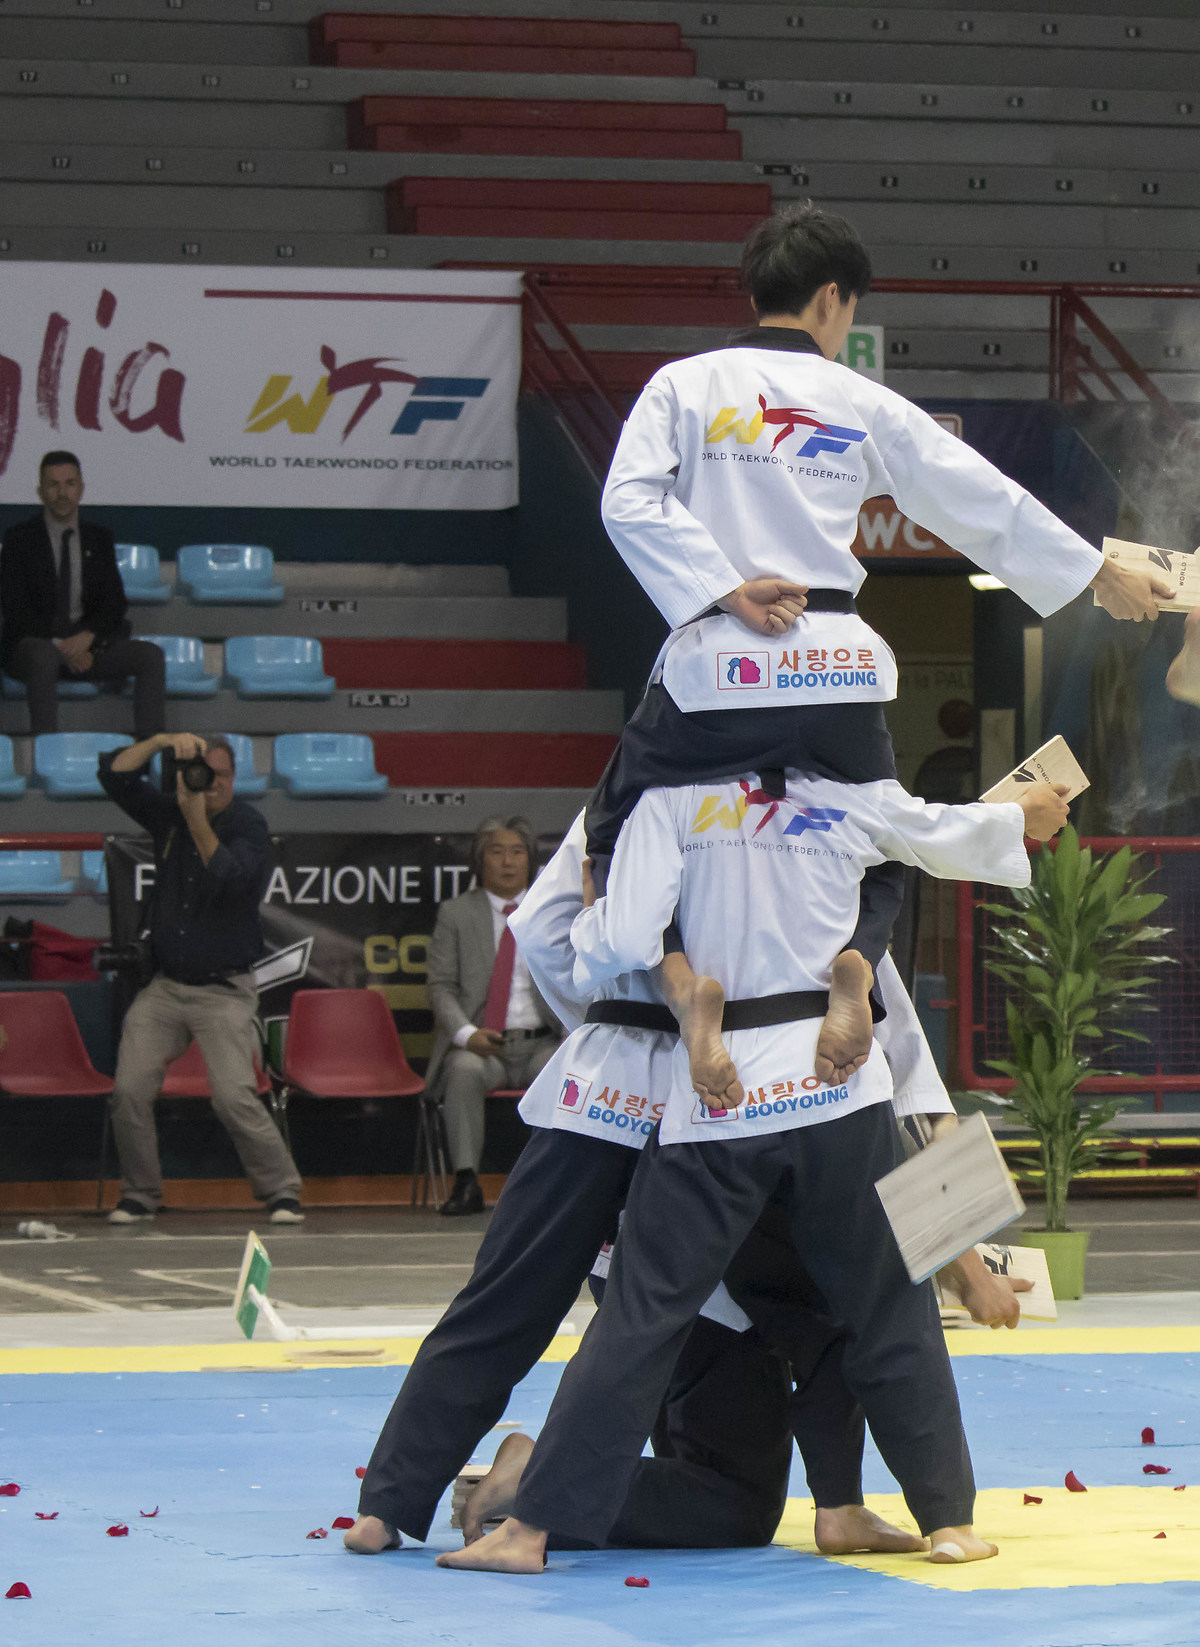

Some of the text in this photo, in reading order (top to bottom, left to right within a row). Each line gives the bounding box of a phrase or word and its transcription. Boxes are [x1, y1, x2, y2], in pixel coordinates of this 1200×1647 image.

[209, 455, 277, 469] WORLD
[283, 456, 399, 471] TAEKWONDO
[859, 512, 936, 550] WC
[777, 649, 877, 671] 사랑으로
[776, 671, 877, 689] BOOYOUNG
[787, 844, 853, 861] FEDERATION
[744, 1085, 849, 1120] BOOYOUNG
[587, 1105, 657, 1136] BOOYO
